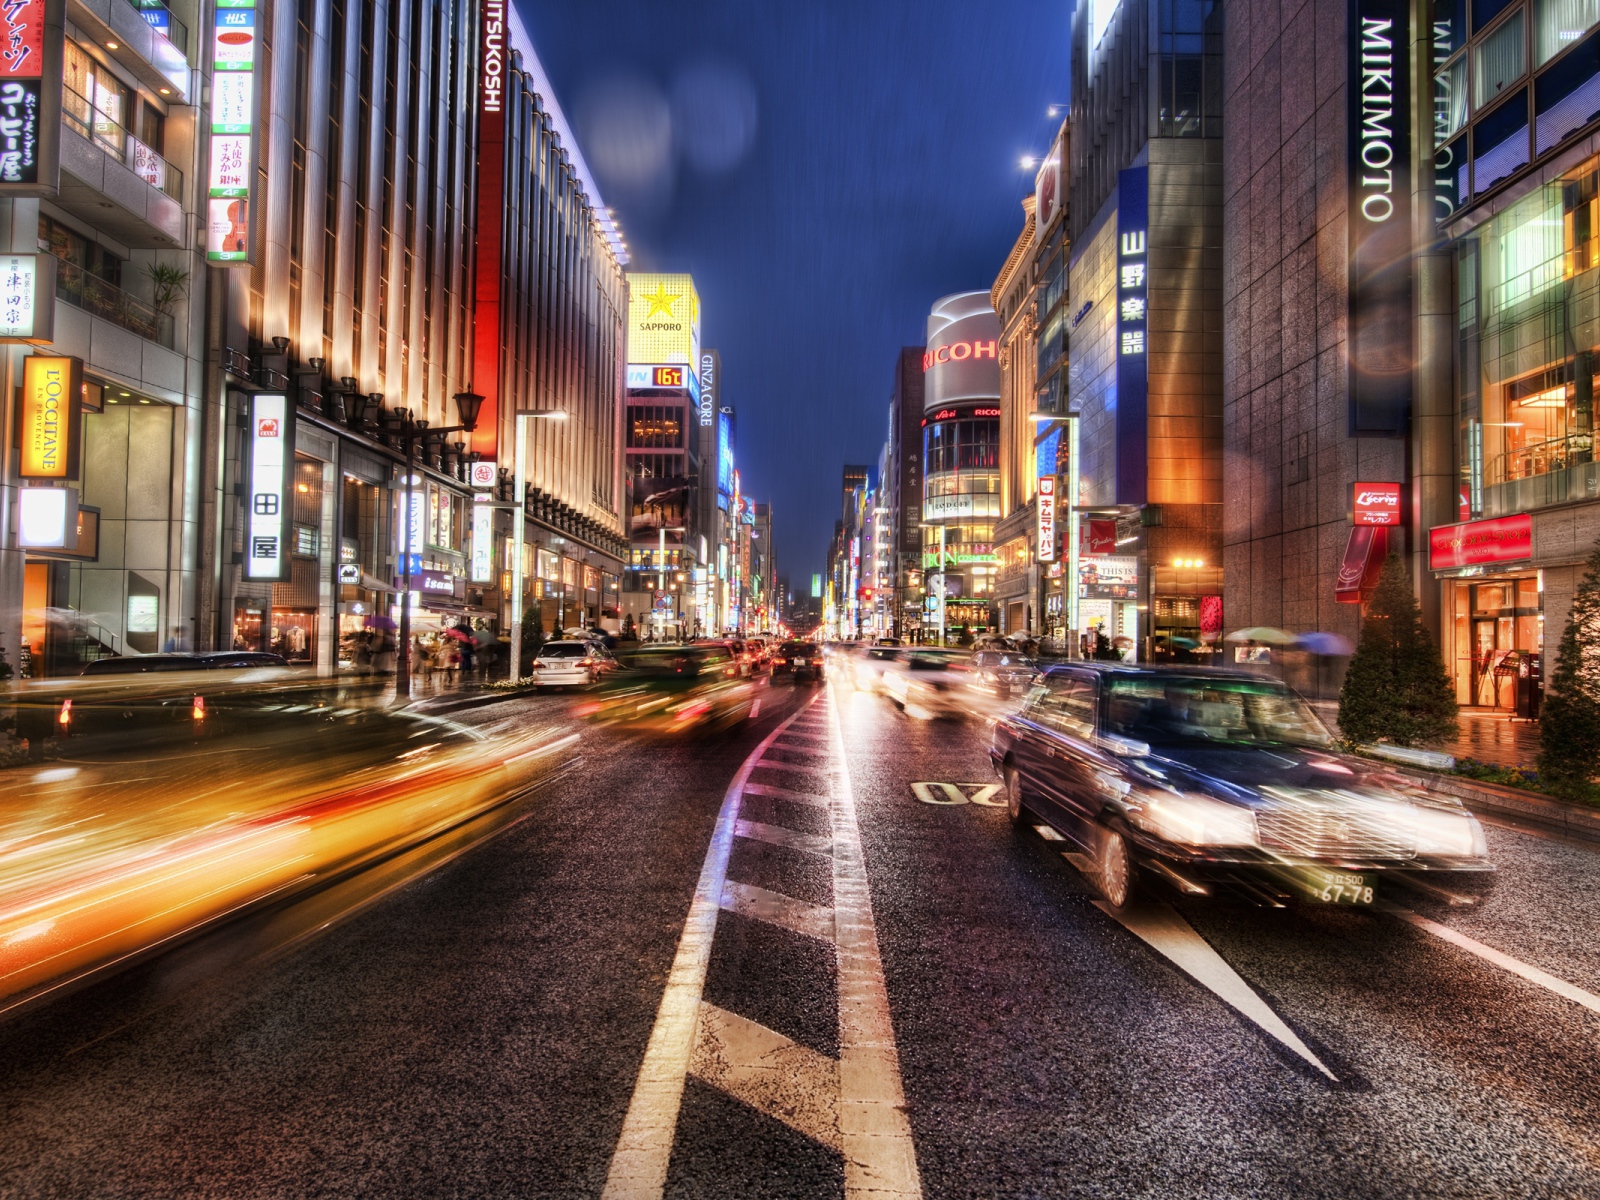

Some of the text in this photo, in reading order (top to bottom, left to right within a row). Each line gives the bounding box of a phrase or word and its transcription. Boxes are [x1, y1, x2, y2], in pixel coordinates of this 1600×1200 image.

[224, 13, 247, 24] HIS
[484, 0, 503, 111] ITSUKOSHI
[0, 83, 24, 181] コーヒー屋
[1361, 16, 1394, 222] MIKIMOTO
[220, 143, 231, 172] すみか
[232, 139, 242, 169] 天使の
[222, 188, 240, 197] 4F
[219, 252, 237, 260] 3F
[1121, 230, 1146, 355] 山野楽器
[639, 322, 682, 331] SAPPORO
[922, 341, 996, 373] RICOH
[700, 354, 714, 427] GINZA CORE
[35, 387, 43, 452] EN PROVENCE
[42, 369, 63, 470] L'OCCITANE
[252, 493, 279, 559] 田屋
[1040, 498, 1053, 557] キムラヤのパン
[1437, 528, 1528, 550] Chocolate Shop
[1091, 536, 1115, 550] Fender
[1101, 567, 1123, 575] THIS
[1124, 567, 1133, 575] IS
[1321, 884, 1374, 904] 67-78
[1345, 875, 1364, 885] 500
